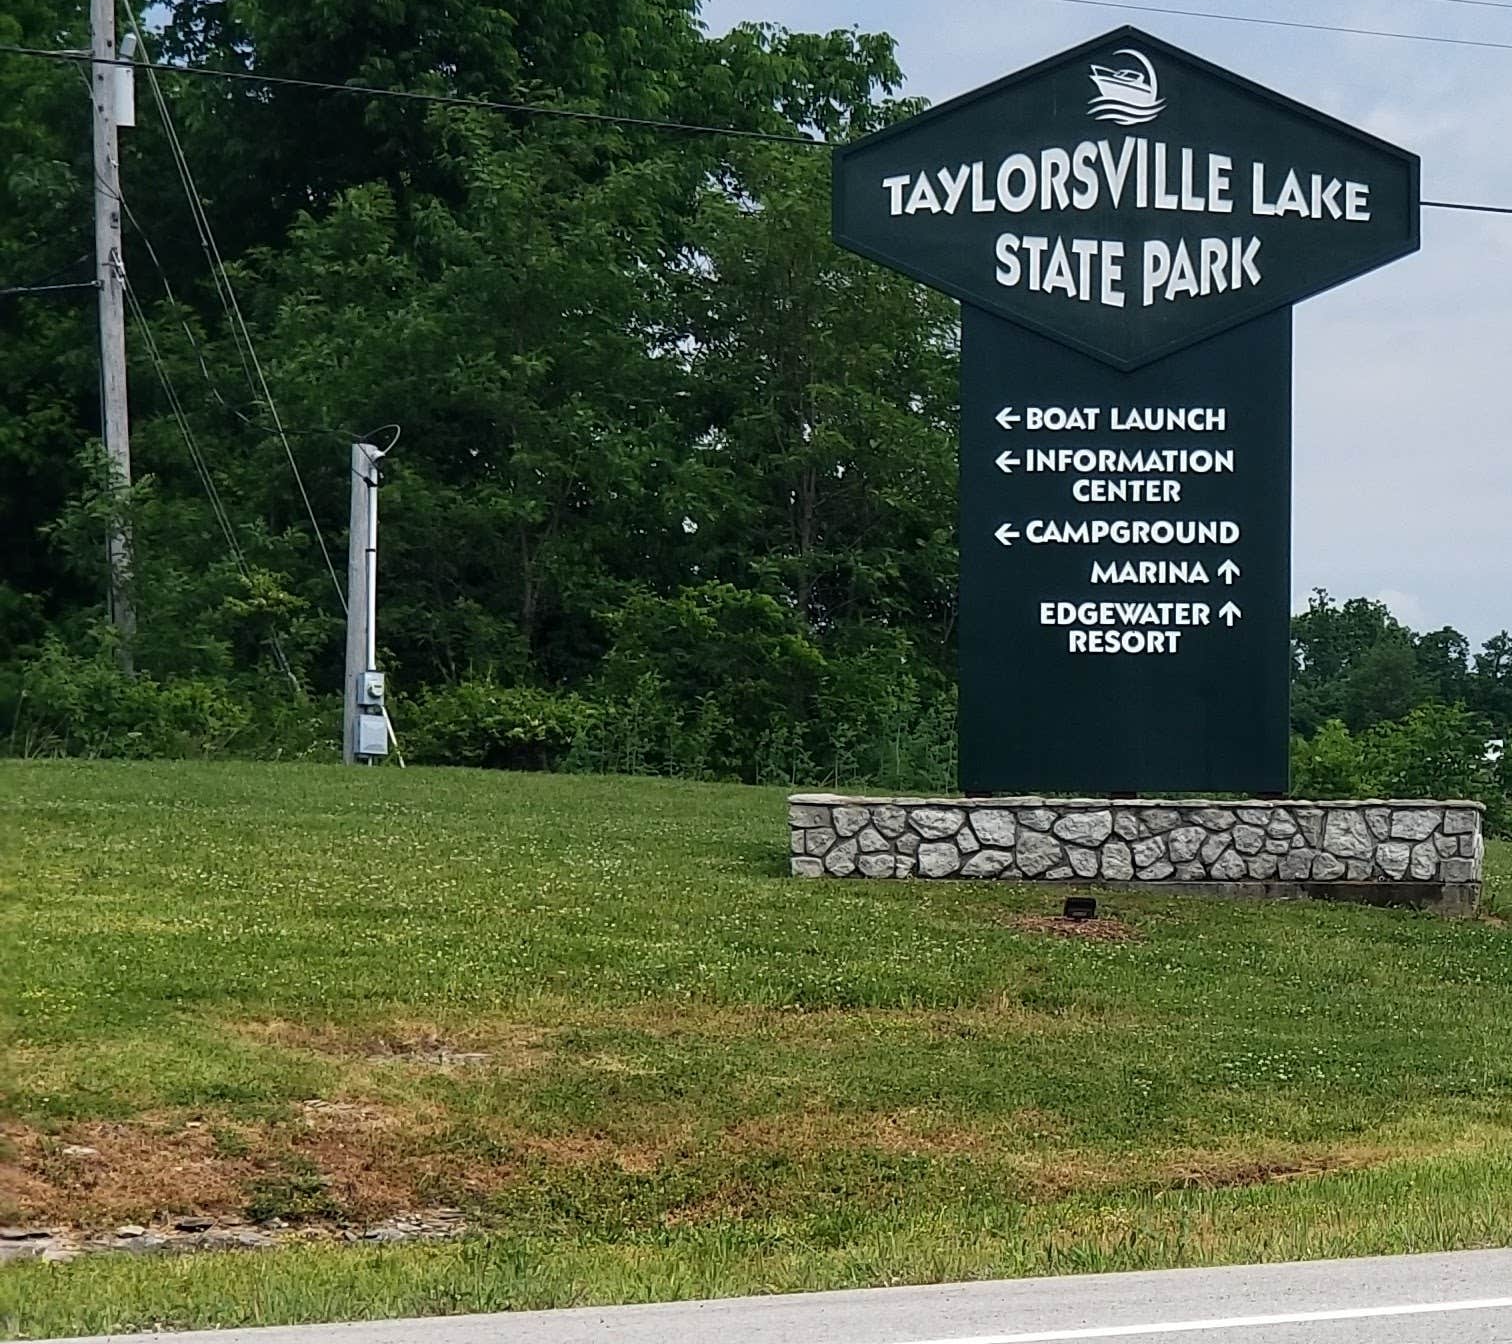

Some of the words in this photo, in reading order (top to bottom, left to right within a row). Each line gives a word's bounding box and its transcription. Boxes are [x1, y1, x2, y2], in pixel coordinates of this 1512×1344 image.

[883, 136, 1232, 215] TAYLORSVILLE
[1253, 163, 1370, 220] LAKE
[996, 233, 1124, 307] STATE
[1143, 236, 1261, 306] PARK
[1027, 408, 1100, 430] BOAT
[1111, 408, 1225, 430] LAUNCH
[1027, 449, 1233, 472] INFORMATION
[1073, 479, 1180, 501] CENTER
[1026, 520, 1239, 543] CAMPGROUND
[1091, 561, 1209, 583] MARINA
[1041, 602, 1209, 625] EDGEWATER
[1070, 630, 1181, 653] RESORT
